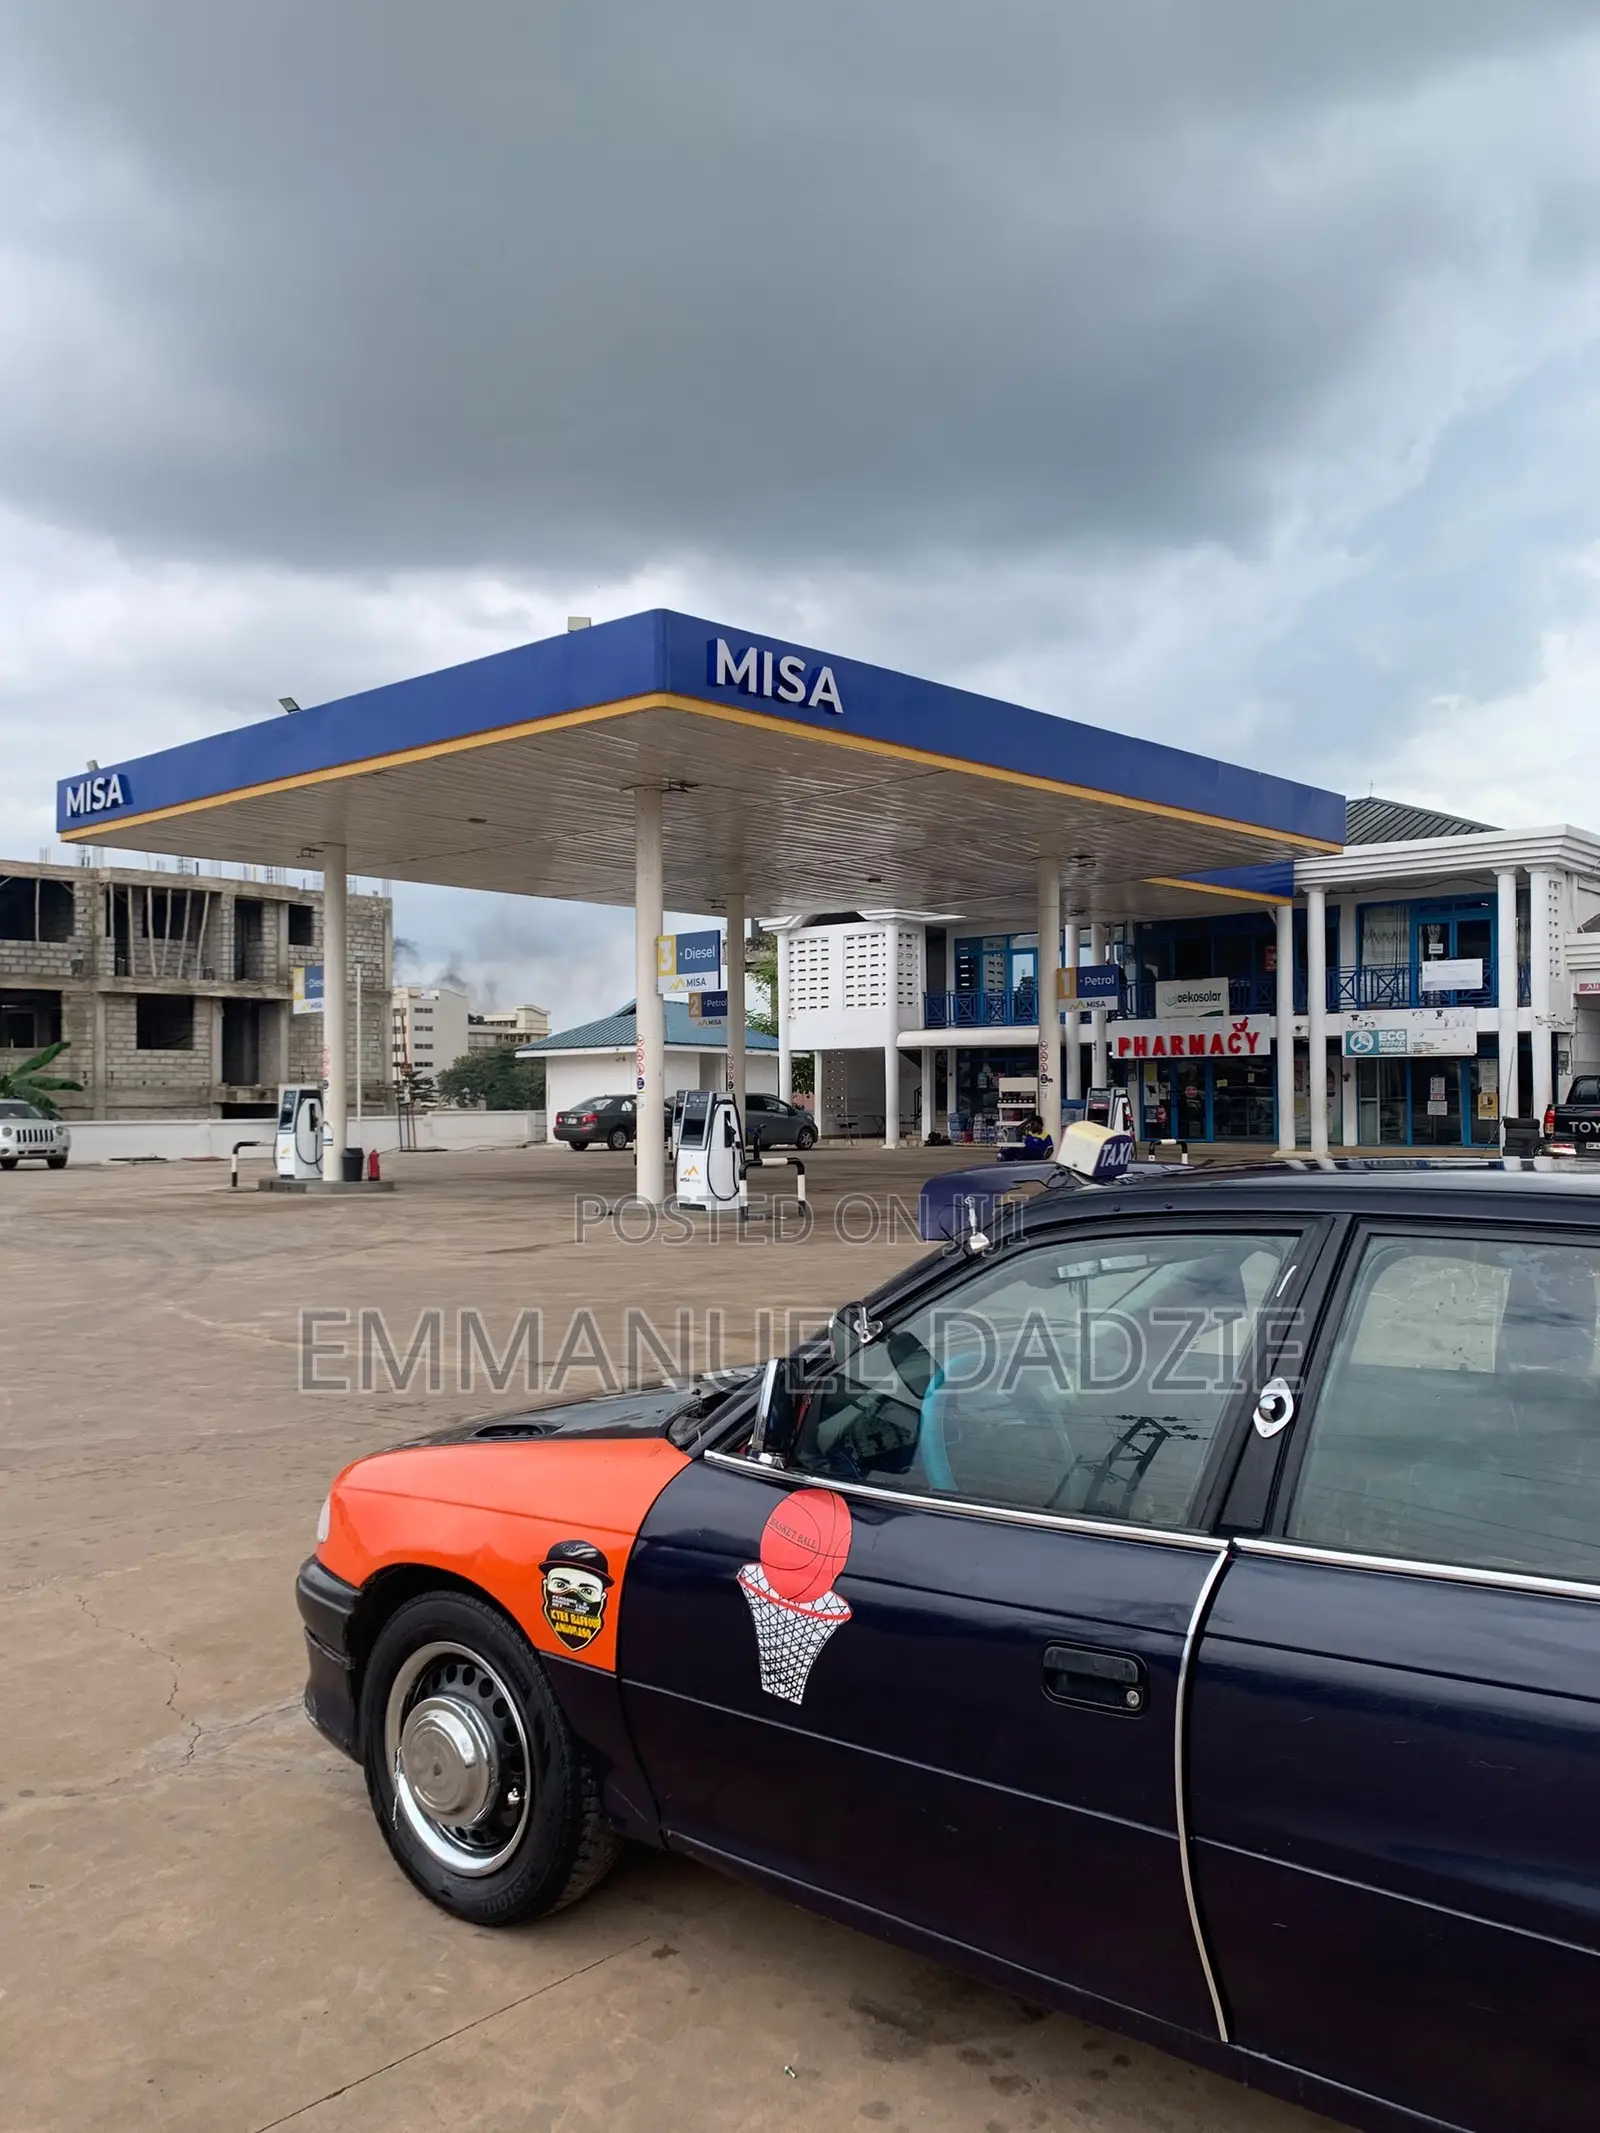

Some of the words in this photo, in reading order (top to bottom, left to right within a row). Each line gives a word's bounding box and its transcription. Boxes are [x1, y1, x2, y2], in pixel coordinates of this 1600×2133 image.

[716, 638, 844, 714] MISA
[66, 773, 124, 817] MISA
[659, 940, 673, 972] 3
[684, 945, 716, 960] Diesel
[686, 977, 707, 988] MISA
[1062, 971, 1071, 996] 1
[1084, 975, 1115, 986] Petrol
[690, 995, 700, 1015] 2
[1086, 1000, 1107, 1009] MISA
[1118, 1032, 1260, 1057] PHARMACY
[1378, 1031, 1406, 1041] ECG
[1100, 1142, 1133, 1167] TAXI
[769, 1517, 797, 1539] BASKET
[797, 1534, 818, 1549] BALL
